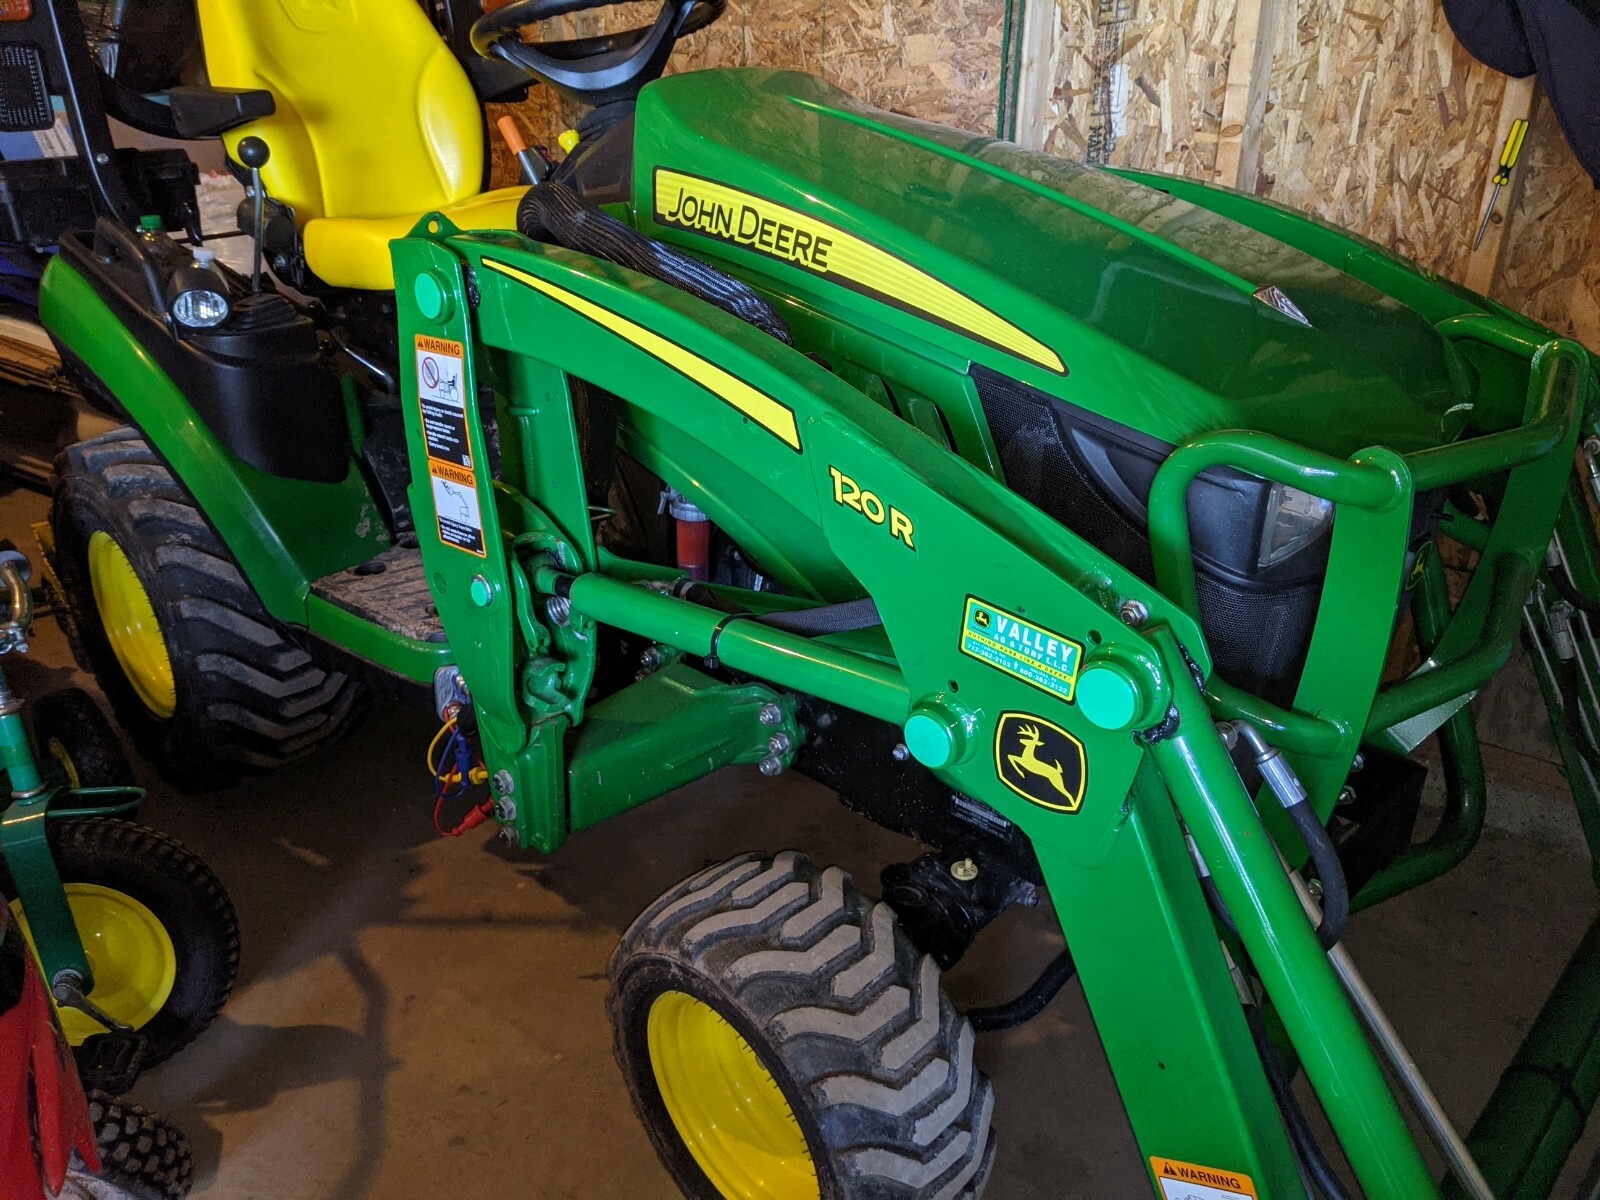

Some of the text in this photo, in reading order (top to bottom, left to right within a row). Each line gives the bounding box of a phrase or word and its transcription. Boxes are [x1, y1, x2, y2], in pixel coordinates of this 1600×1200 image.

[668, 187, 833, 269] JOHN DEERE
[423, 338, 460, 355] WARNING
[436, 466, 473, 485] WARNING
[968, 631, 997, 648] NOTHING
[999, 645, 1017, 657] RUNS
[1019, 655, 1035, 665] LIKE
[993, 633, 1070, 673] AG & TURF L.L.C.
[996, 615, 1073, 663] VALLEY
[967, 642, 1011, 668] 717-362-3132
[1019, 667, 1068, 695] 800-362-3132
[1177, 1166, 1241, 1189] WARNING
